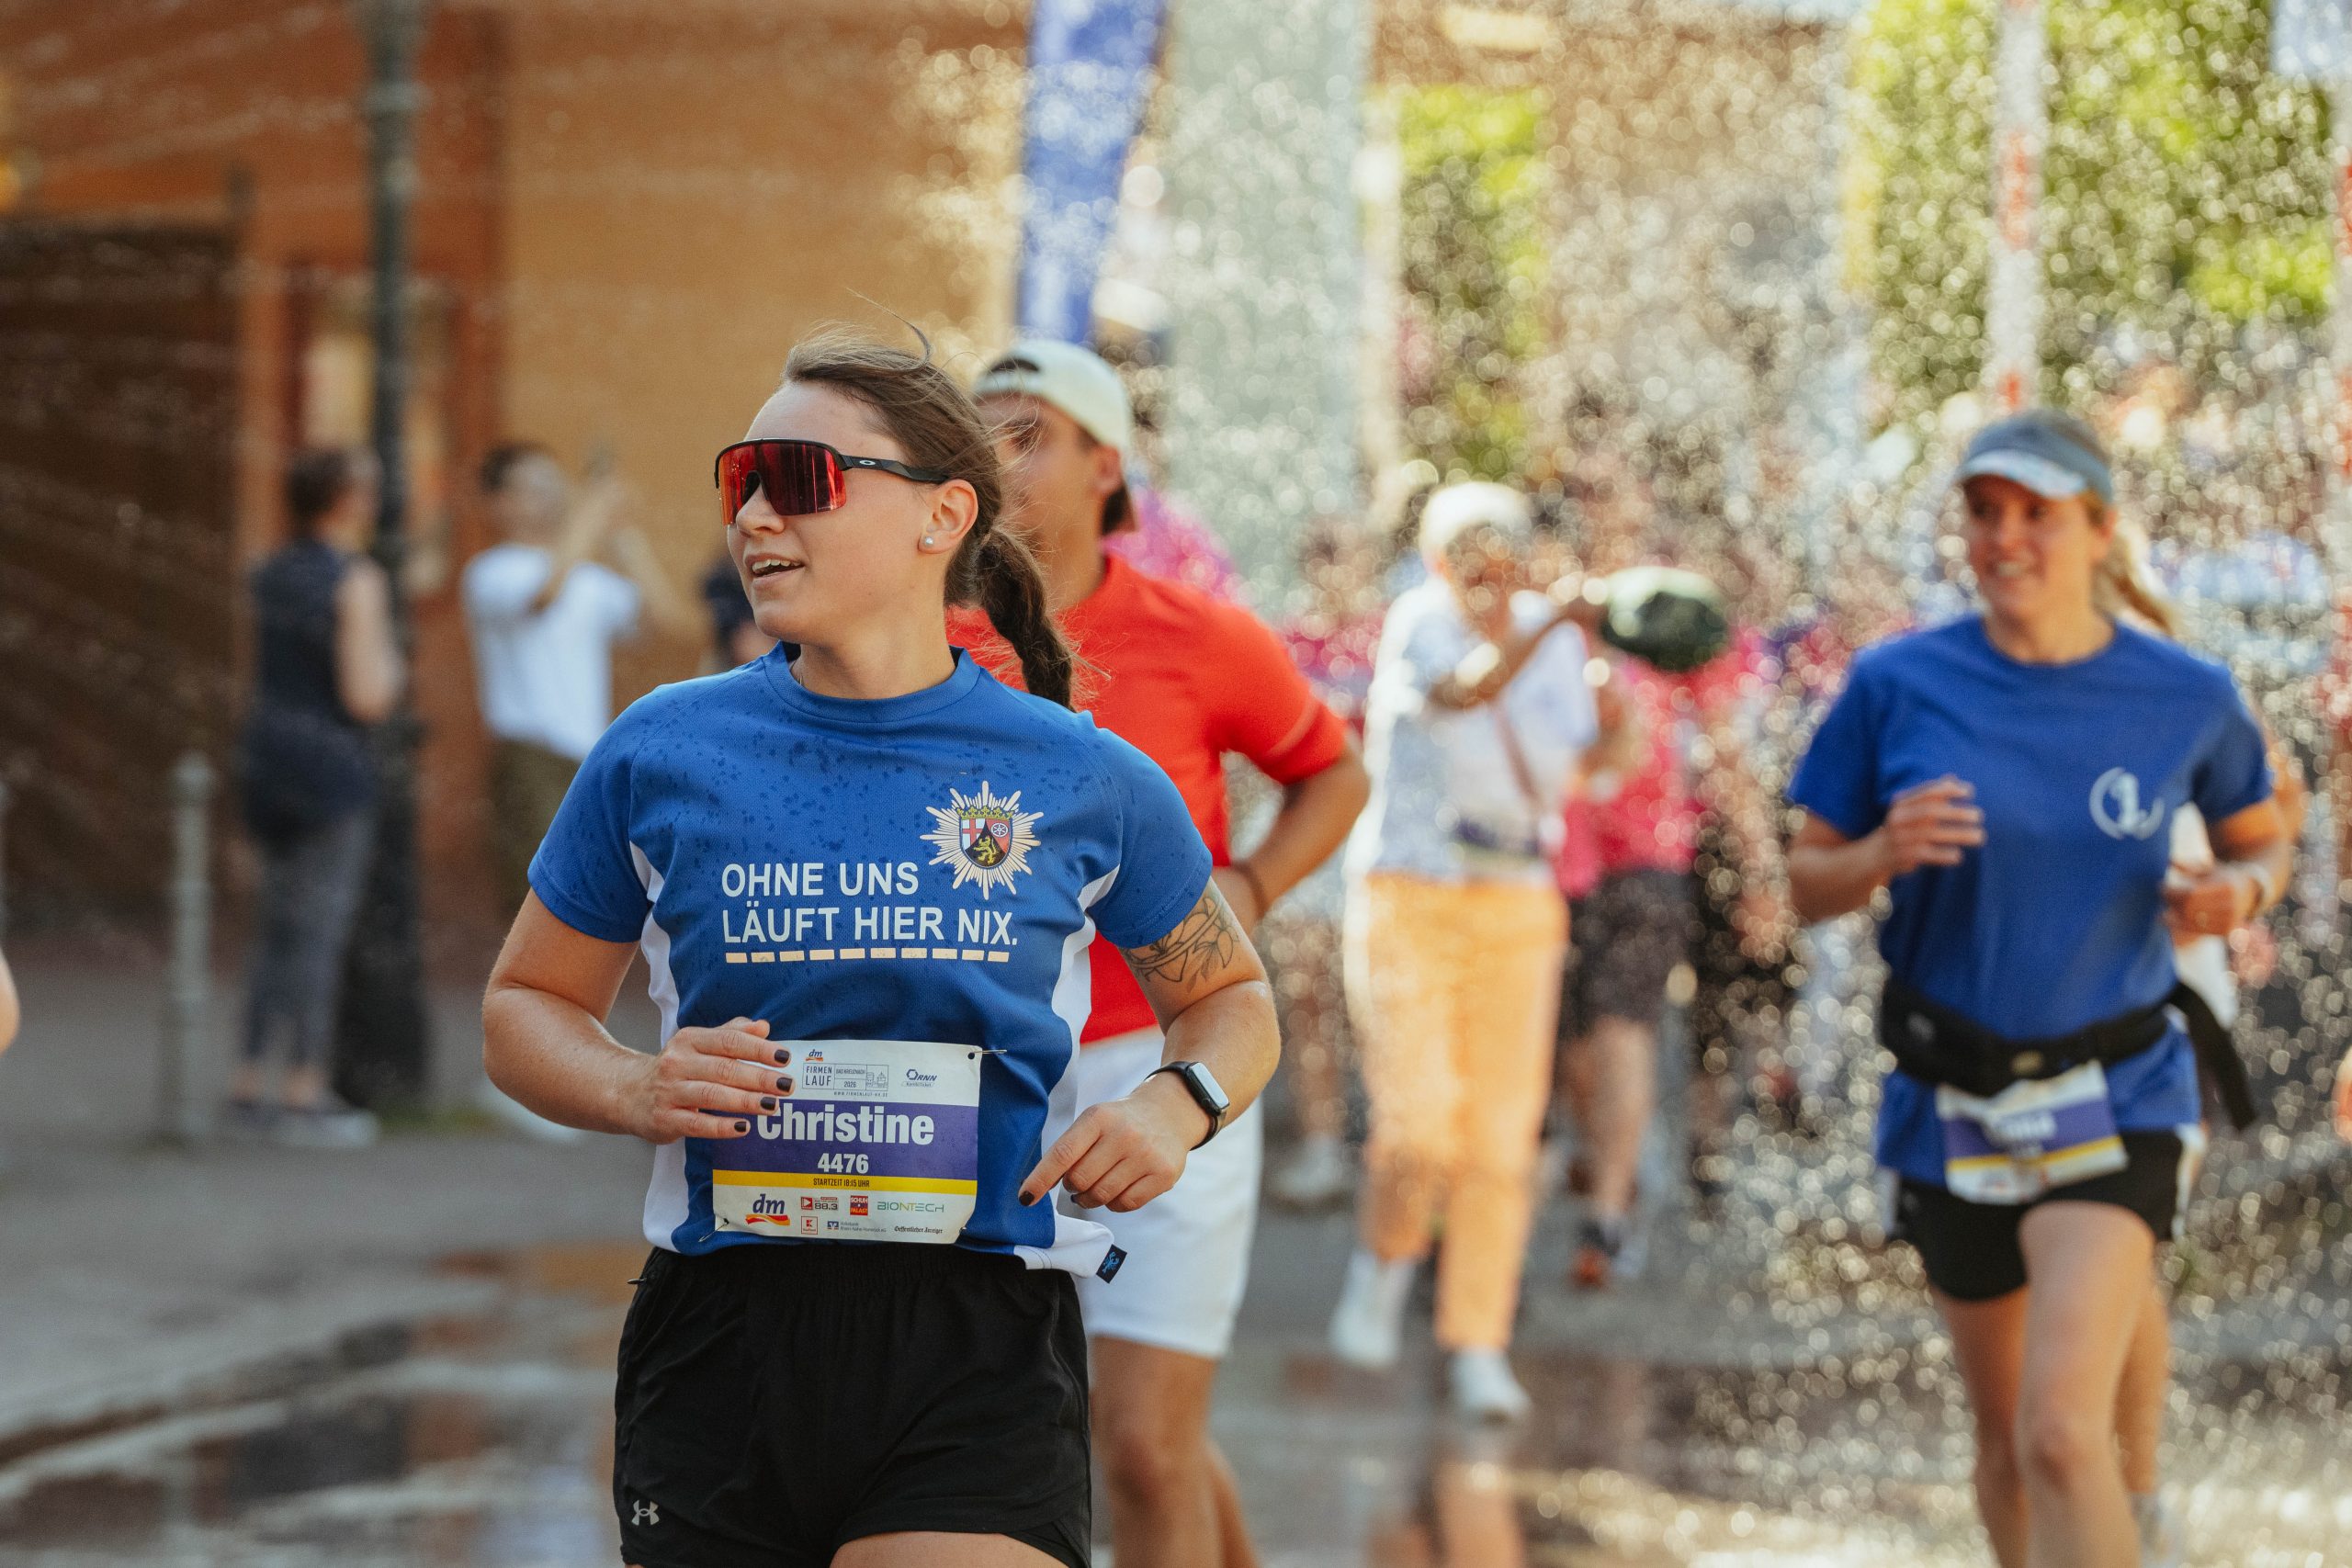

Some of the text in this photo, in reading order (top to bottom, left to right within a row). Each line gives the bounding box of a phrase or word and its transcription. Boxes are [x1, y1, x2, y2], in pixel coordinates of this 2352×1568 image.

[721, 862, 920, 897] OHNE UNS
[722, 900, 1018, 946] LÄUFT HIER NIX.
[808, 1048, 823, 1057] dm
[806, 1066, 832, 1075] FIRMEN
[805, 1075, 832, 1087] LAUF
[756, 1102, 935, 1145] Christine
[817, 1152, 869, 1174] 4476
[813, 1178, 870, 1188] STARTZEIT 18:15 UHR
[752, 1193, 786, 1214] dm
[850, 1196, 868, 1204] SCHUH
[814, 1202, 839, 1211] 88.3
[876, 1201, 945, 1213] BIONTECH
